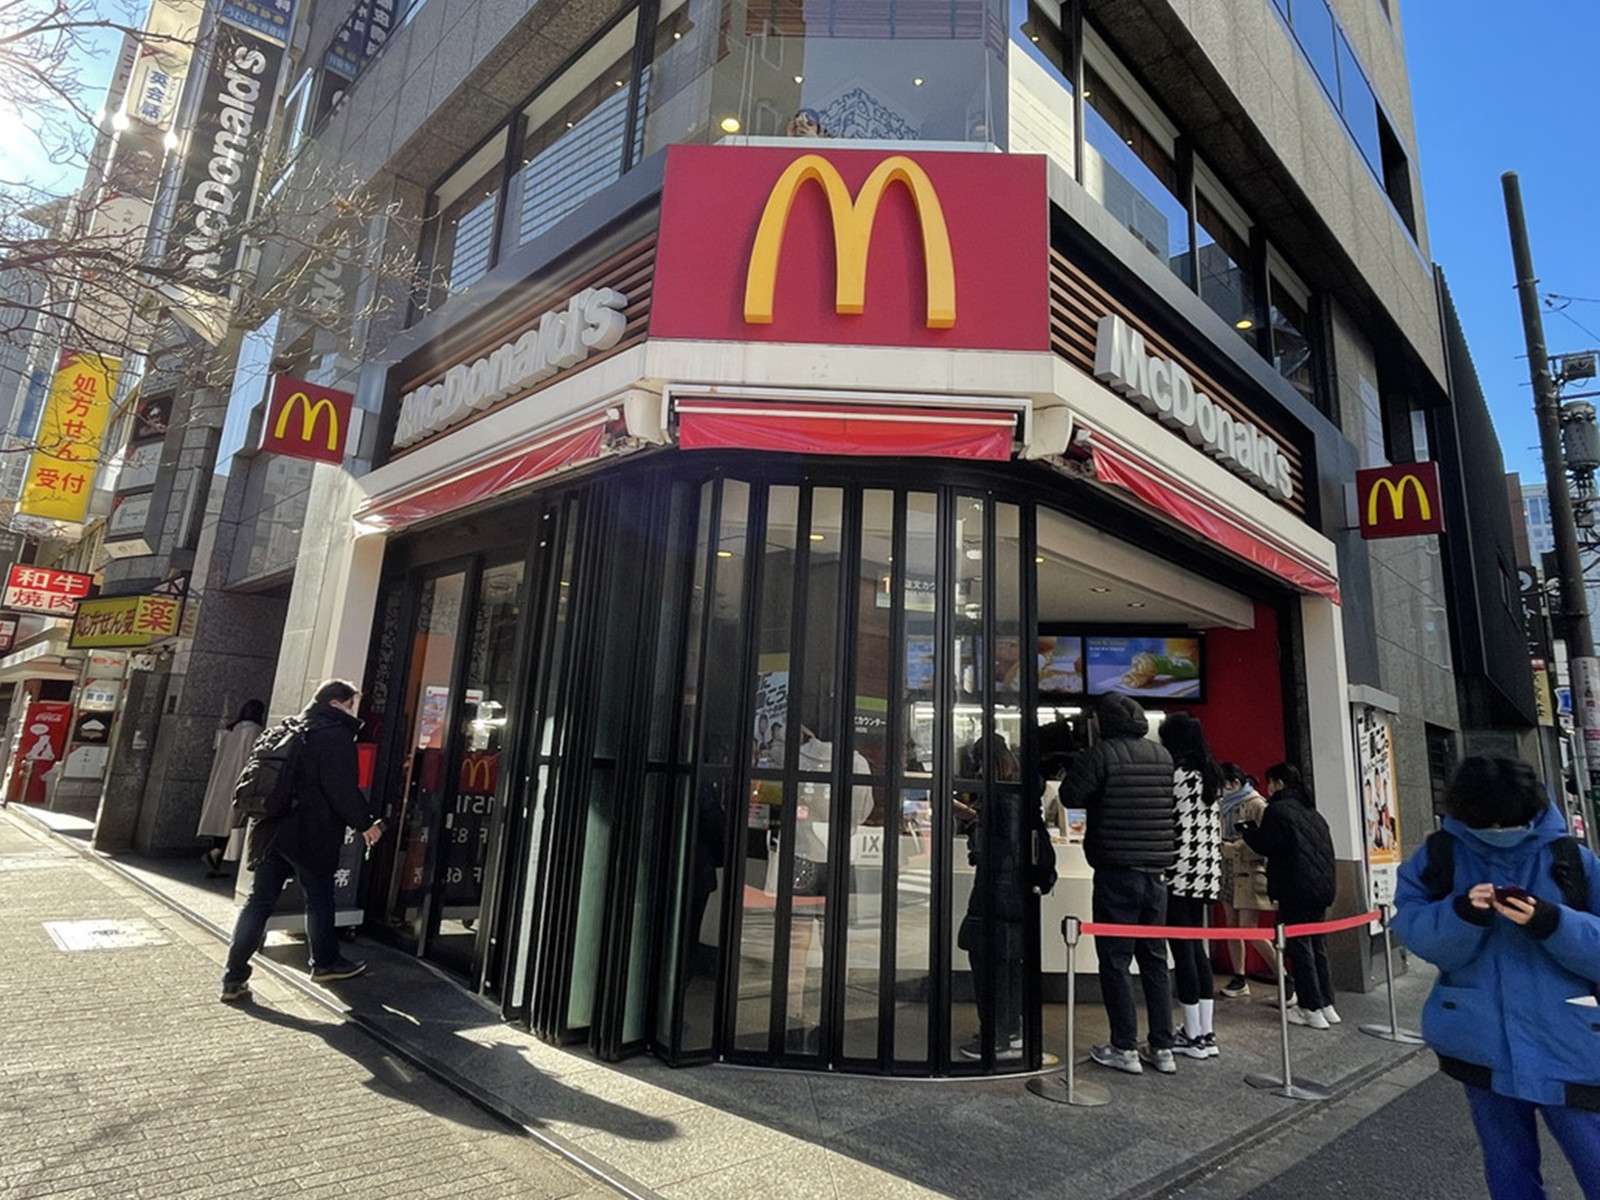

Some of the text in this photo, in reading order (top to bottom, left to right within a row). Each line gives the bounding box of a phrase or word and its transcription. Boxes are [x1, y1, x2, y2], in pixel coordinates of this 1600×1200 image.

[393, 286, 628, 448] McDonald's
[1094, 314, 1293, 499] McDonald's
[35, 467, 86, 495] 受付
[17, 569, 84, 592] 和牛
[12, 590, 77, 613] 焼肉
[137, 598, 176, 633] 薬
